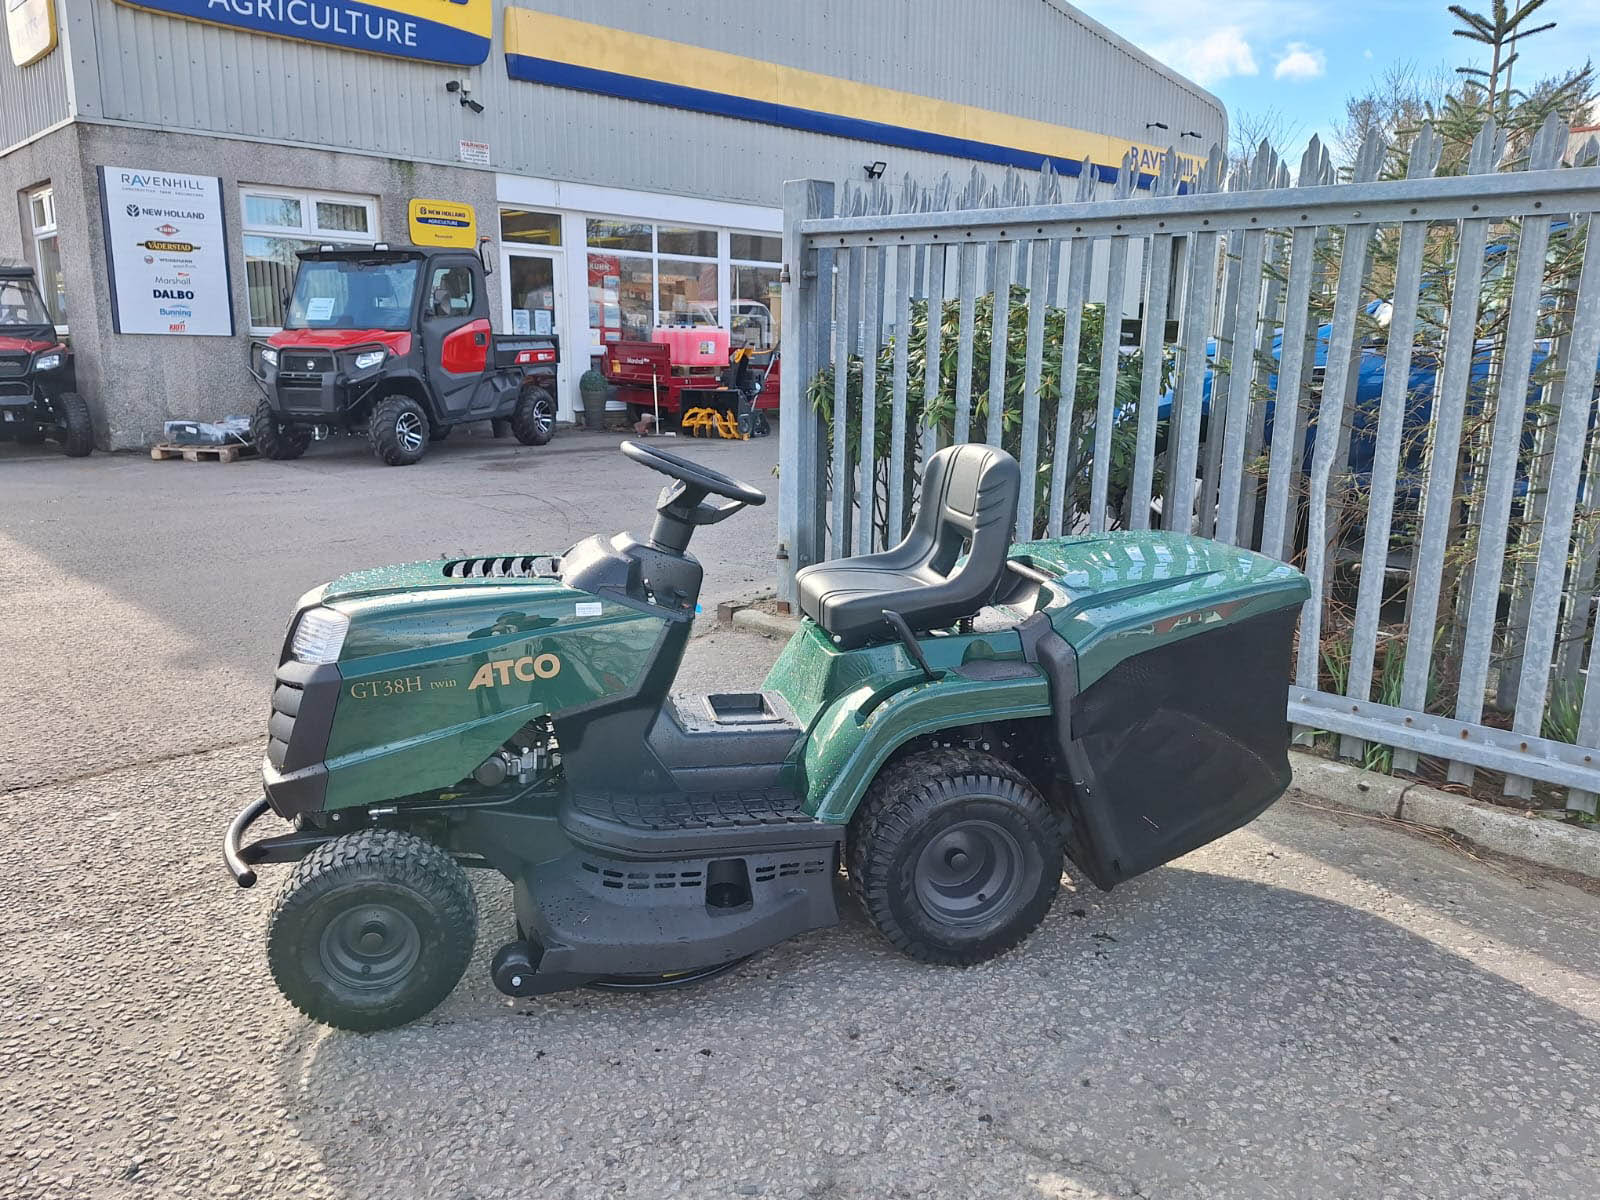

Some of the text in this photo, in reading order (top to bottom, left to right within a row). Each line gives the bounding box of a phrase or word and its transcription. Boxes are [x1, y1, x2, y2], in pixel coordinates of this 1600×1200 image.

[121, 173, 205, 191] RAVENHILL
[142, 208, 205, 220] NEW HOLLAND
[589, 262, 611, 271] KUHN
[155, 276, 191, 286] Marshall
[153, 289, 194, 300] DALBO
[159, 307, 192, 318] Bunning
[351, 652, 561, 699] GT38H twin ATCO
